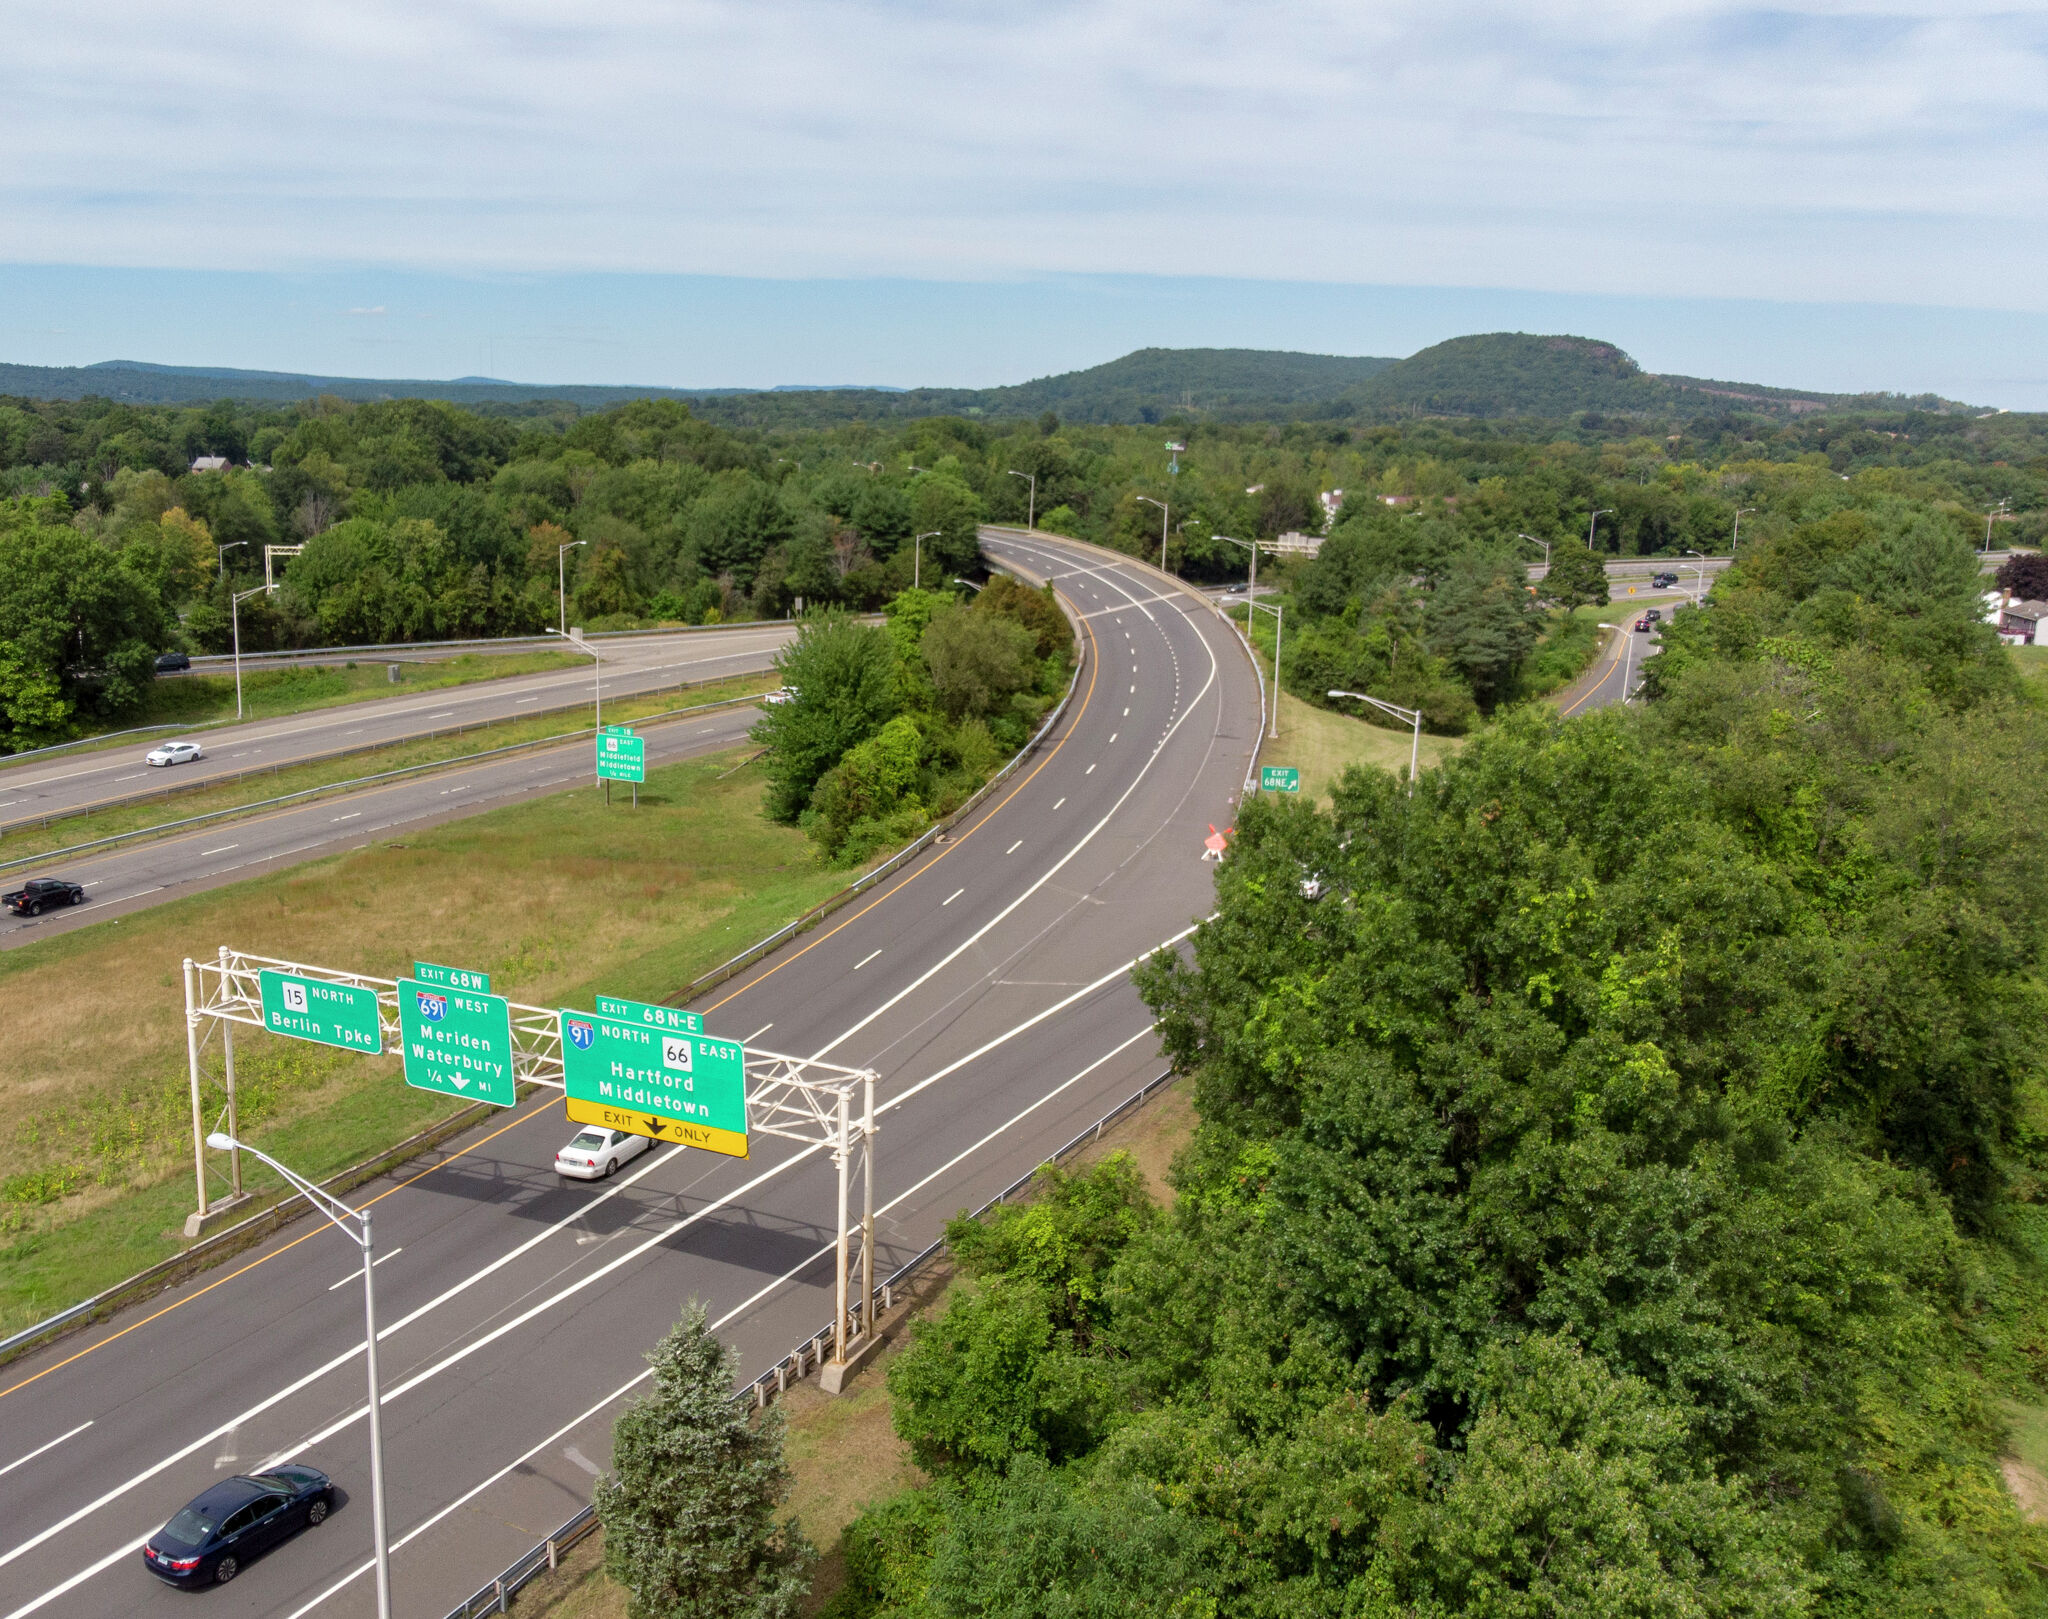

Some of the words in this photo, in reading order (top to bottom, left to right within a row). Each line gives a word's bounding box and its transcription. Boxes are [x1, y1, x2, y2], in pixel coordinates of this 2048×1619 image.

[600, 751, 640, 762] Middlefield
[600, 760, 640, 771] Middletown
[420, 968, 444, 981] EXIT
[450, 972, 482, 990] 68W
[287, 989, 303, 1006] 15
[312, 987, 354, 1006] NORTH
[420, 1000, 445, 1018] 691
[454, 998, 489, 1014] WEST
[272, 1012, 321, 1035] Berlin
[334, 1024, 372, 1046] Tpke
[601, 1002, 628, 1016] EXIT
[643, 1008, 698, 1031] 68N-E
[420, 1024, 492, 1052] Meriden
[571, 1028, 590, 1046] 91
[601, 1024, 650, 1045] NORTH
[667, 1046, 688, 1064] 66
[699, 1043, 737, 1061] EAST
[412, 1043, 503, 1078] Waterbury
[427, 1068, 443, 1084] 1/4
[478, 1081, 492, 1093] MI
[611, 1061, 694, 1092] Hartford
[600, 1080, 710, 1118] Middletown
[604, 1111, 633, 1126] EXIT
[674, 1126, 712, 1144] ONLY
